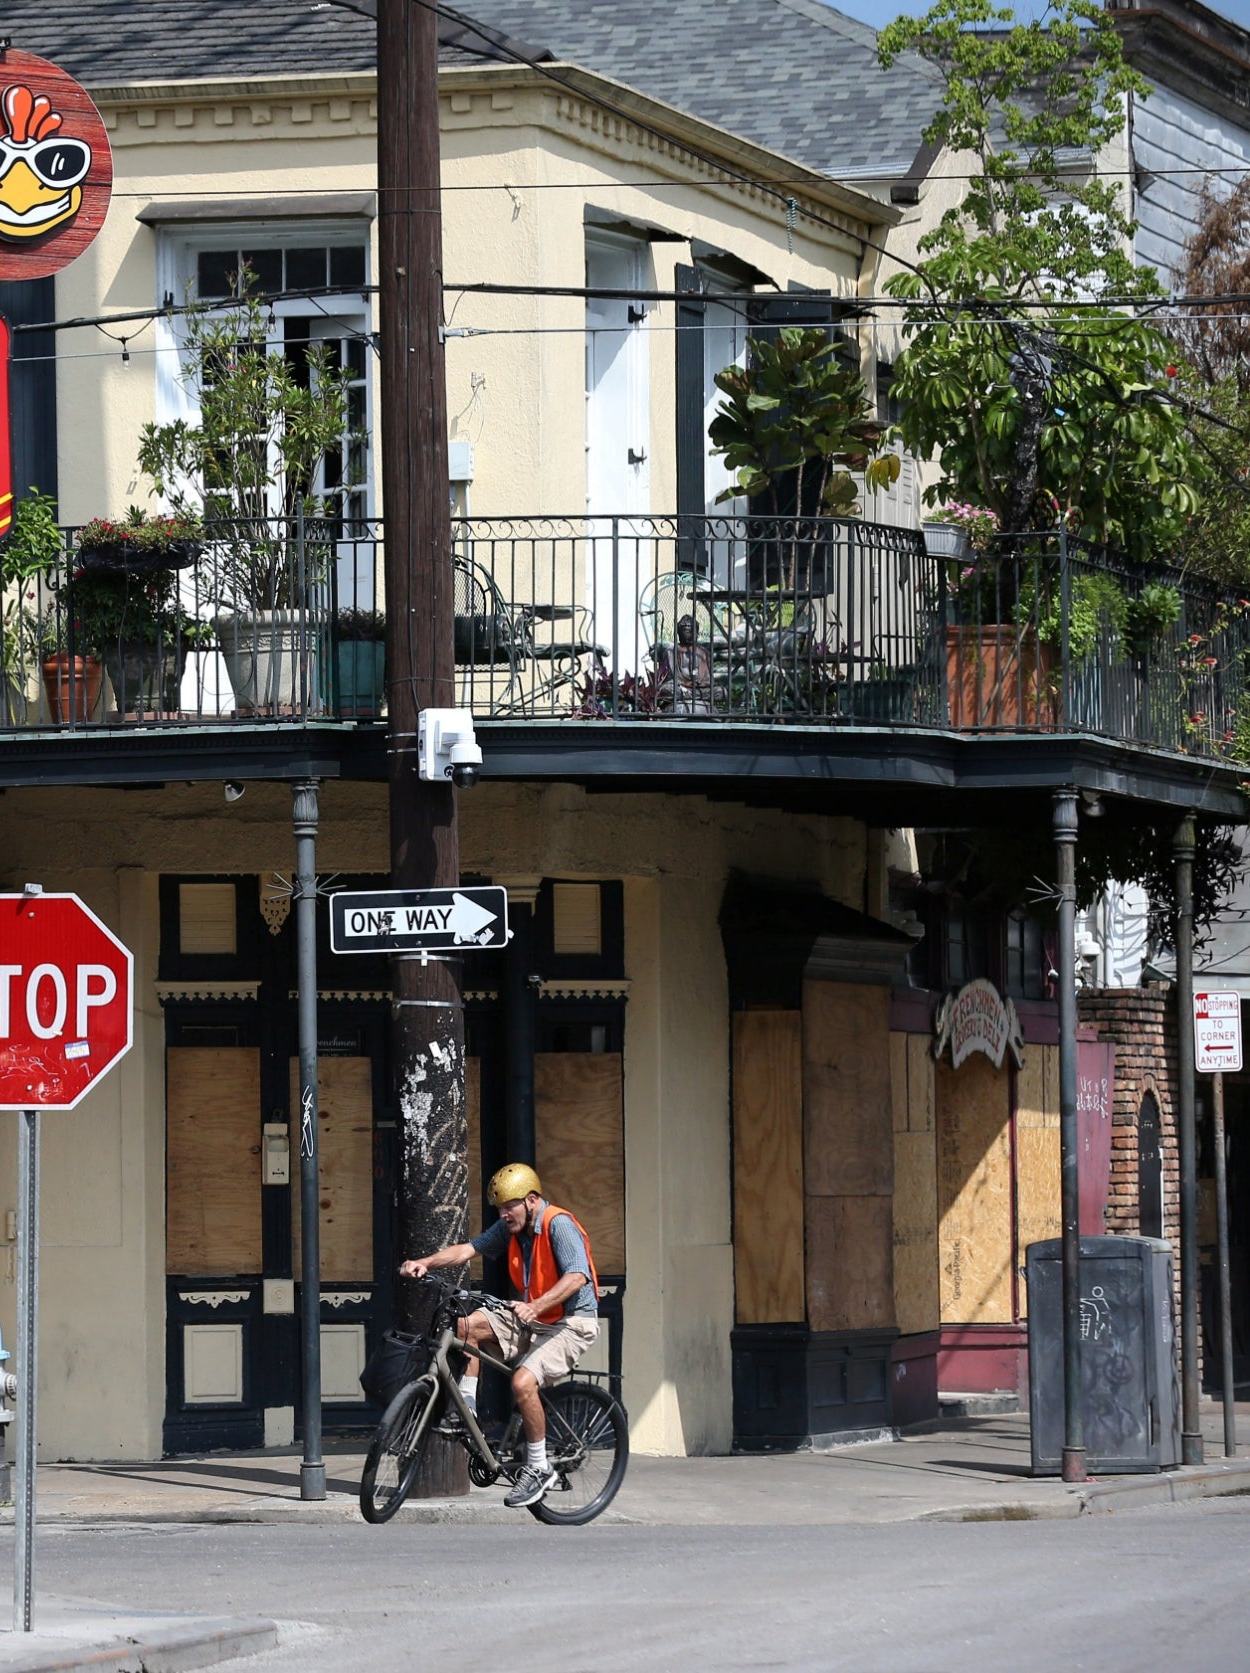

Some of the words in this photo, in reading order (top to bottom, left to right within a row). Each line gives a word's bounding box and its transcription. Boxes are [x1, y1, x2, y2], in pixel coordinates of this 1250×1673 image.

[351, 911, 396, 933] ONE
[406, 908, 453, 931] WAY
[1208, 1000, 1238, 1011] STOPPING
[1213, 1020, 1223, 1029] TO
[1201, 1031, 1236, 1041] CORNER
[1200, 1055, 1238, 1064] ANYTIME
